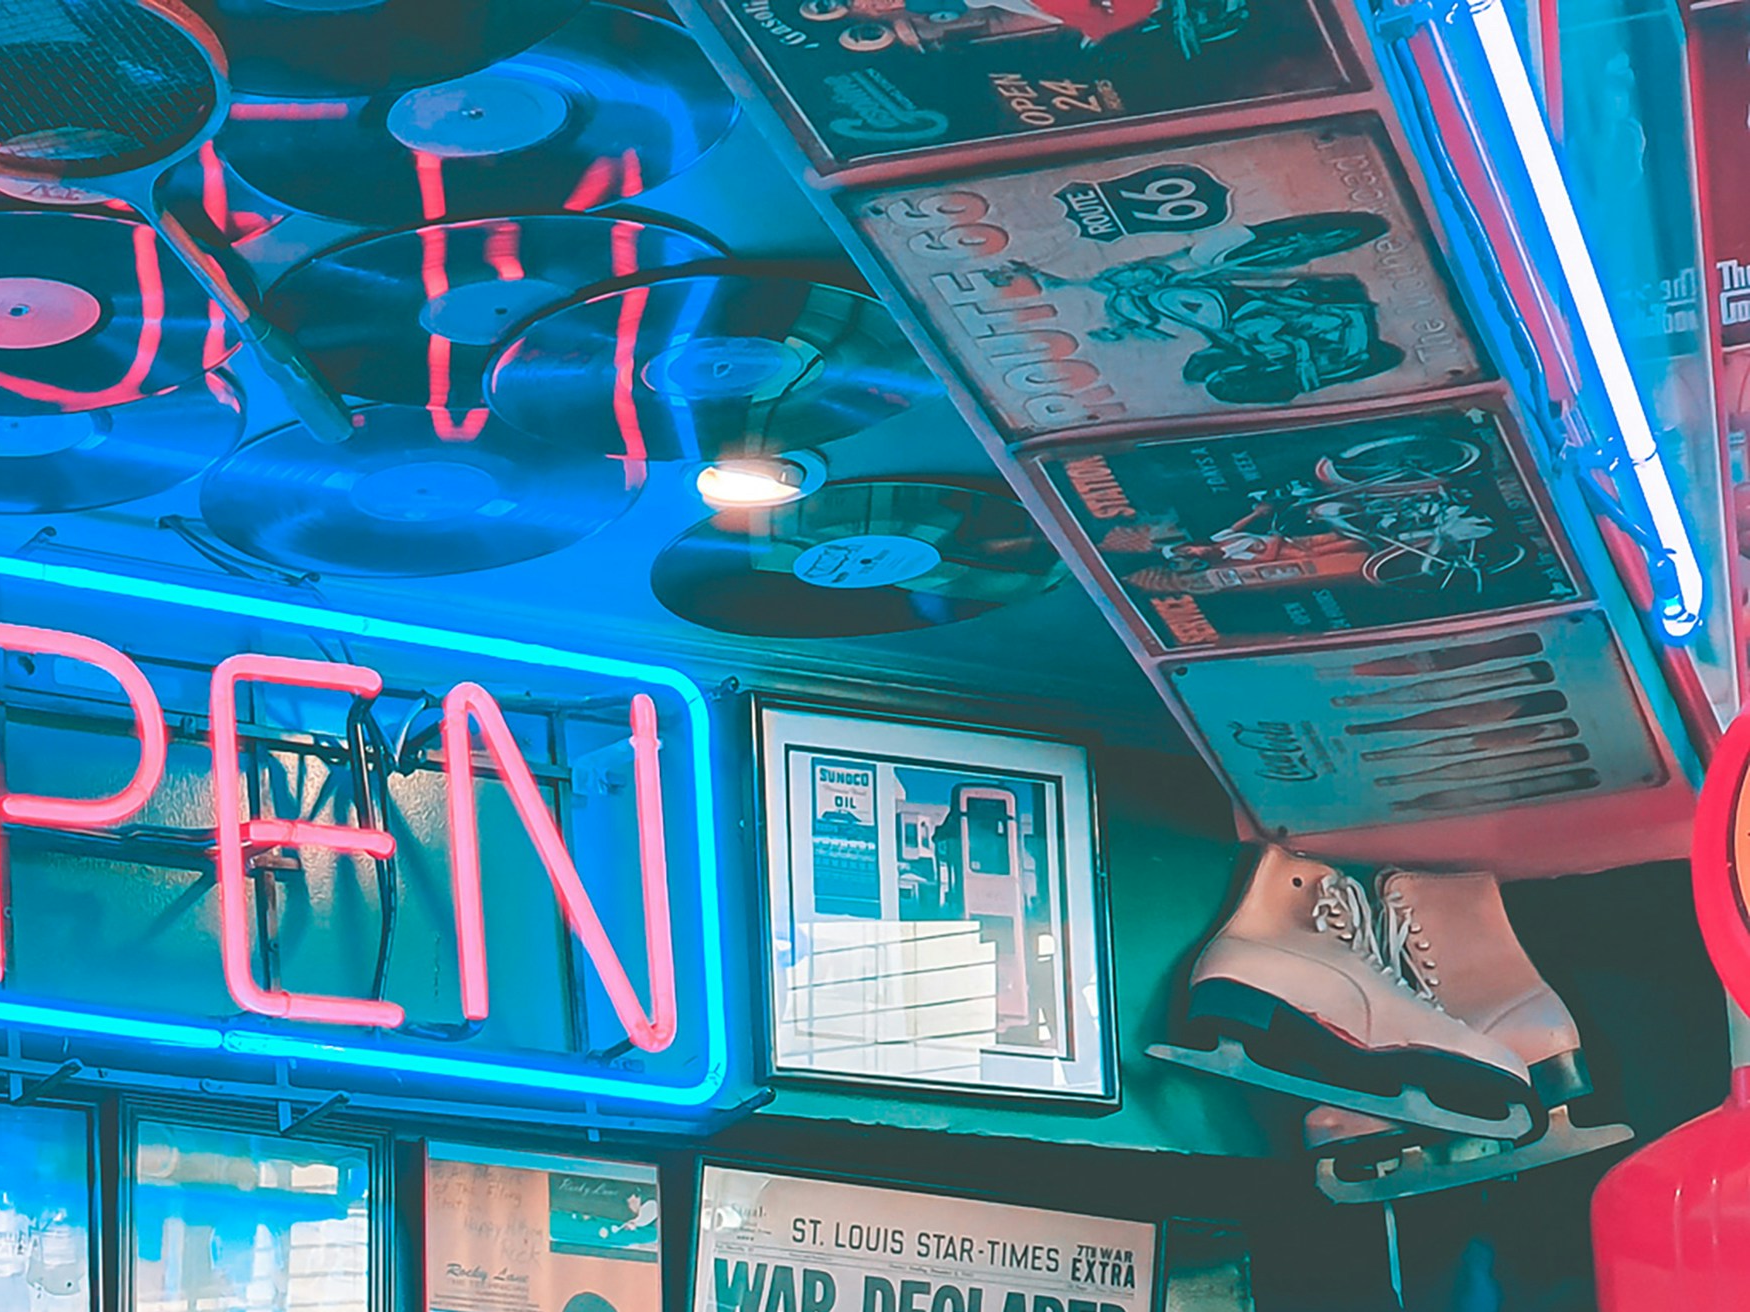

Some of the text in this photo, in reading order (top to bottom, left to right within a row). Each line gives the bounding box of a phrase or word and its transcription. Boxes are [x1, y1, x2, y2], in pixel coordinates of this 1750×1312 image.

[988, 73, 1054, 127] OPEN
[1039, 79, 1102, 113] 24
[1066, 189, 1117, 236] ROUTE
[1120, 177, 1209, 223] 66
[885, 191, 1010, 257] 66
[931, 268, 1127, 426] ROUTE
[1411, 318, 1457, 365] The
[1065, 454, 1136, 519] STATION
[1150, 594, 1219, 645] SERVICE
[819, 767, 870, 788] SUNOCO
[835, 796, 857, 810] OIL
[792, 1217, 825, 1247] ST.
[834, 1221, 905, 1255] LOUIS
[916, 1231, 1061, 1273] STAR-TIMES
[1099, 1247, 1134, 1264] WAR
[446, 1262, 488, 1281] Rocky
[1070, 1257, 1136, 1290] EXTRA
